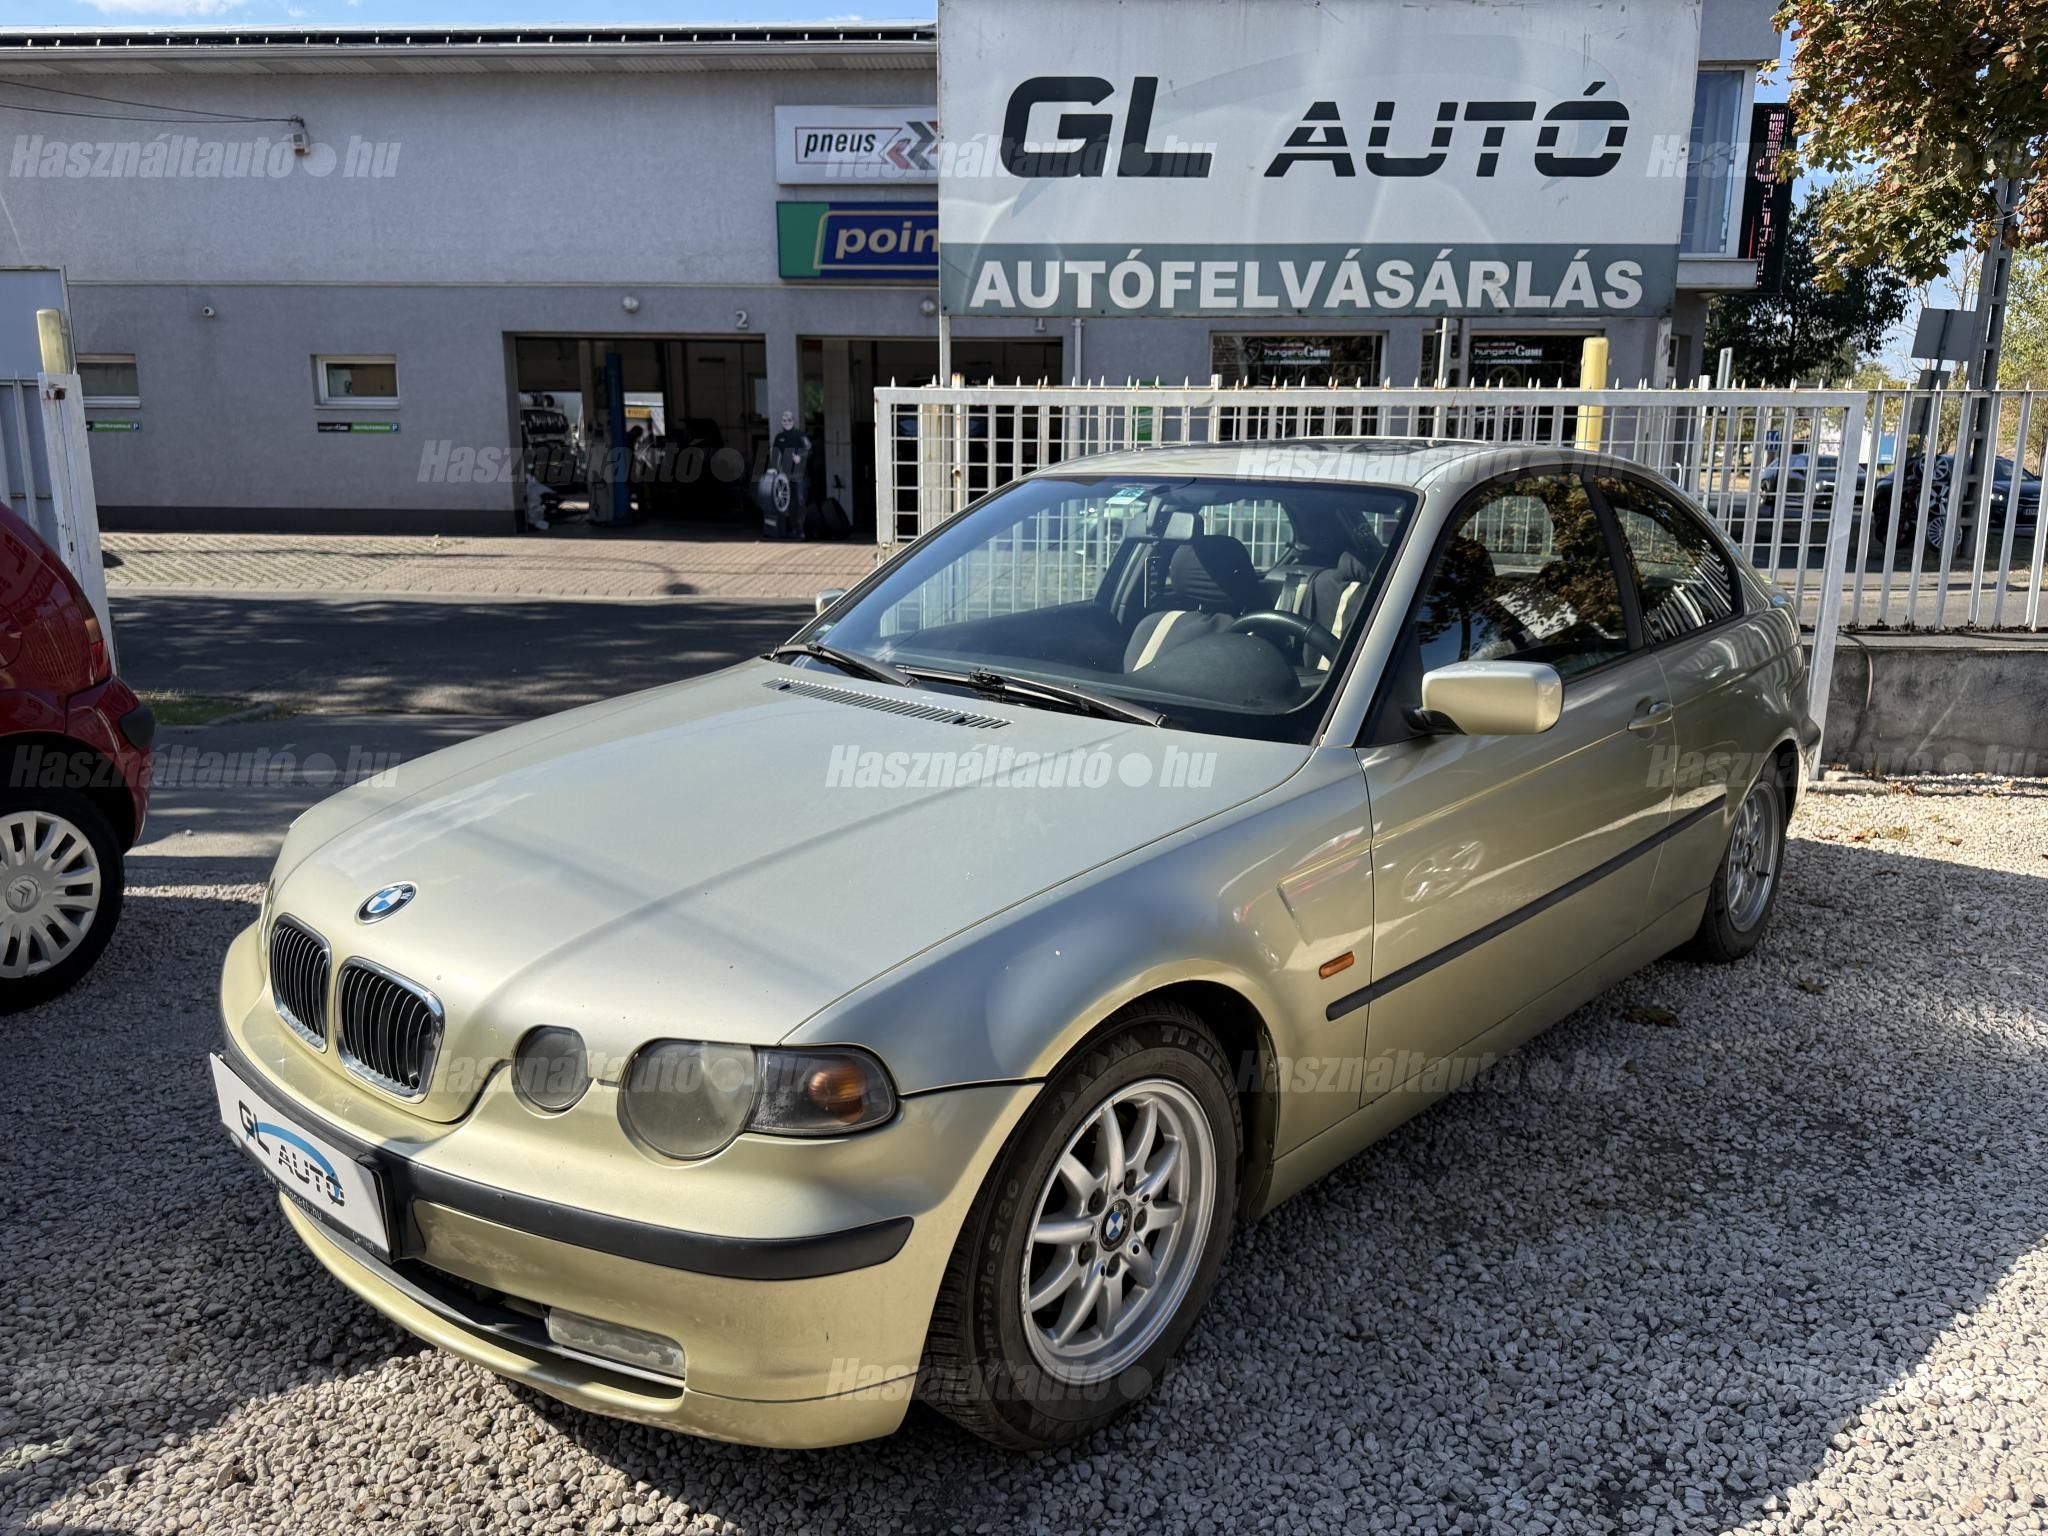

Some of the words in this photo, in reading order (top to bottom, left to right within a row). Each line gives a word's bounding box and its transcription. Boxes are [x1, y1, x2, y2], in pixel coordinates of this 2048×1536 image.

[804, 132, 876, 158] pneus
[1000, 76, 1213, 178] GL
[1263, 81, 1630, 178] AUTÓ
[969, 249, 1644, 309] AUTÓFELVÁSÁRLÁS
[735, 310, 748, 329] 2
[238, 1099, 270, 1155] GL
